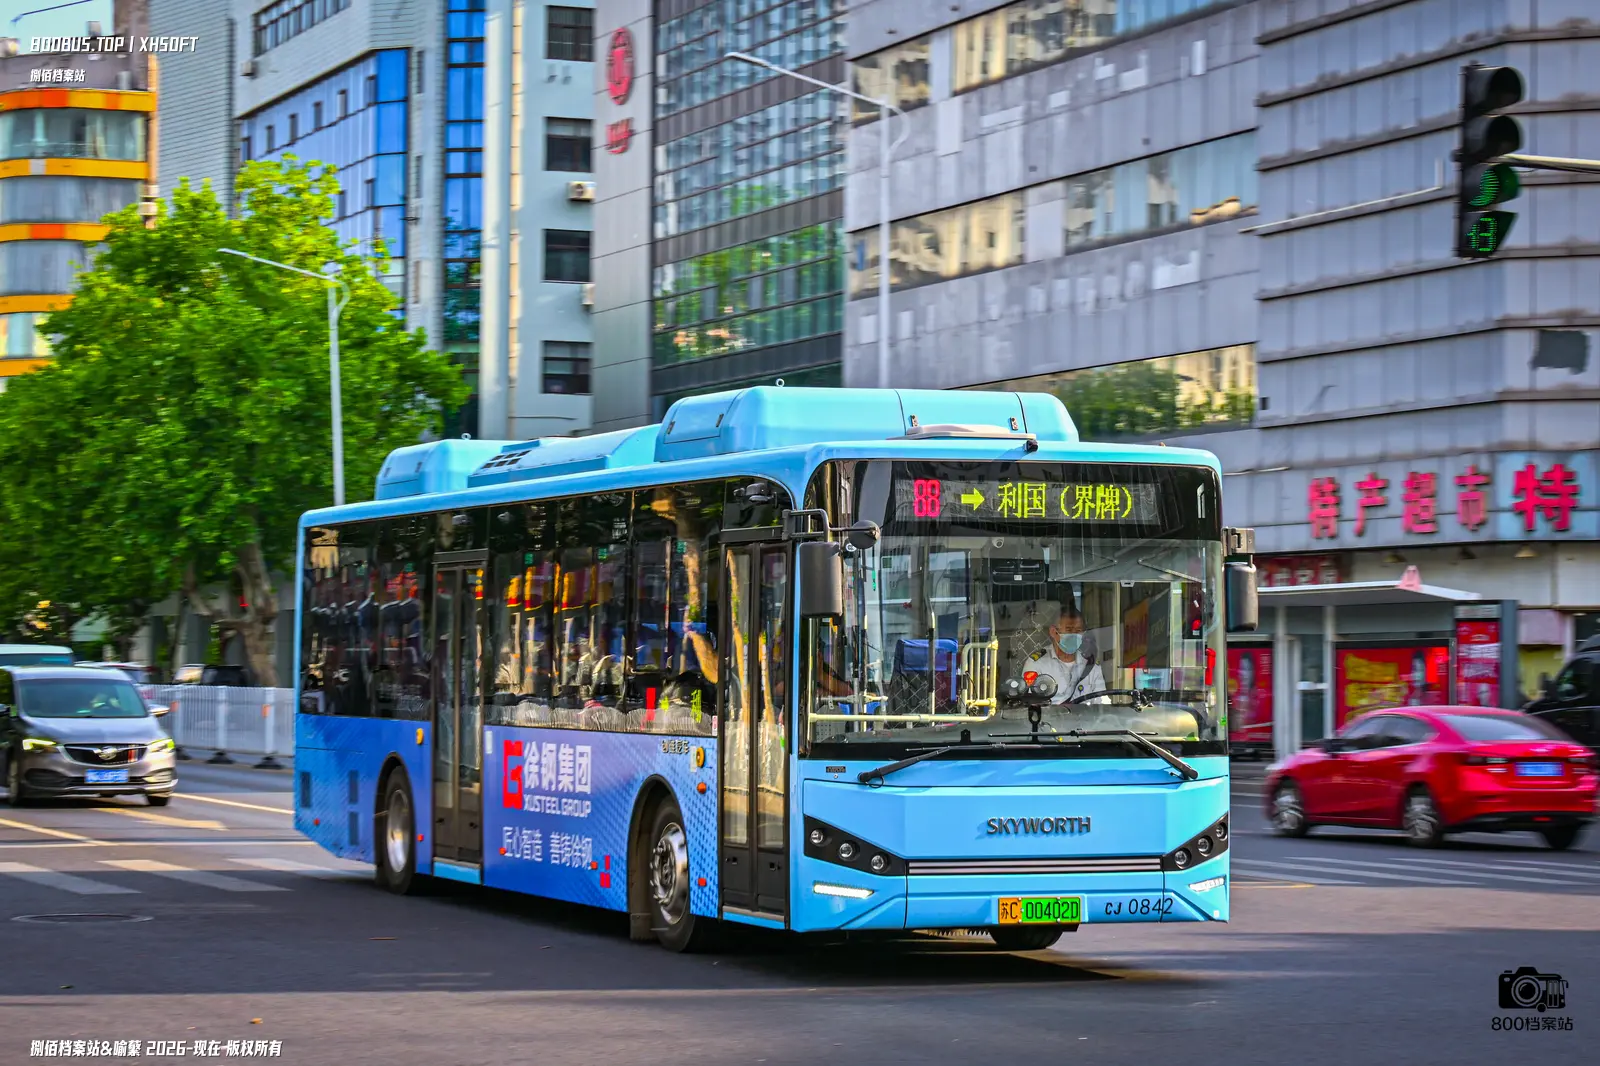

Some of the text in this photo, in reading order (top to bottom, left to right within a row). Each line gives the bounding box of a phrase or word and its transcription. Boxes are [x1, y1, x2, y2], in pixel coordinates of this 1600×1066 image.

[524, 740, 592, 794] 徐钢集团
[986, 816, 1092, 835] SKYWORTH
[1105, 897, 1174, 916] CJ 0842
